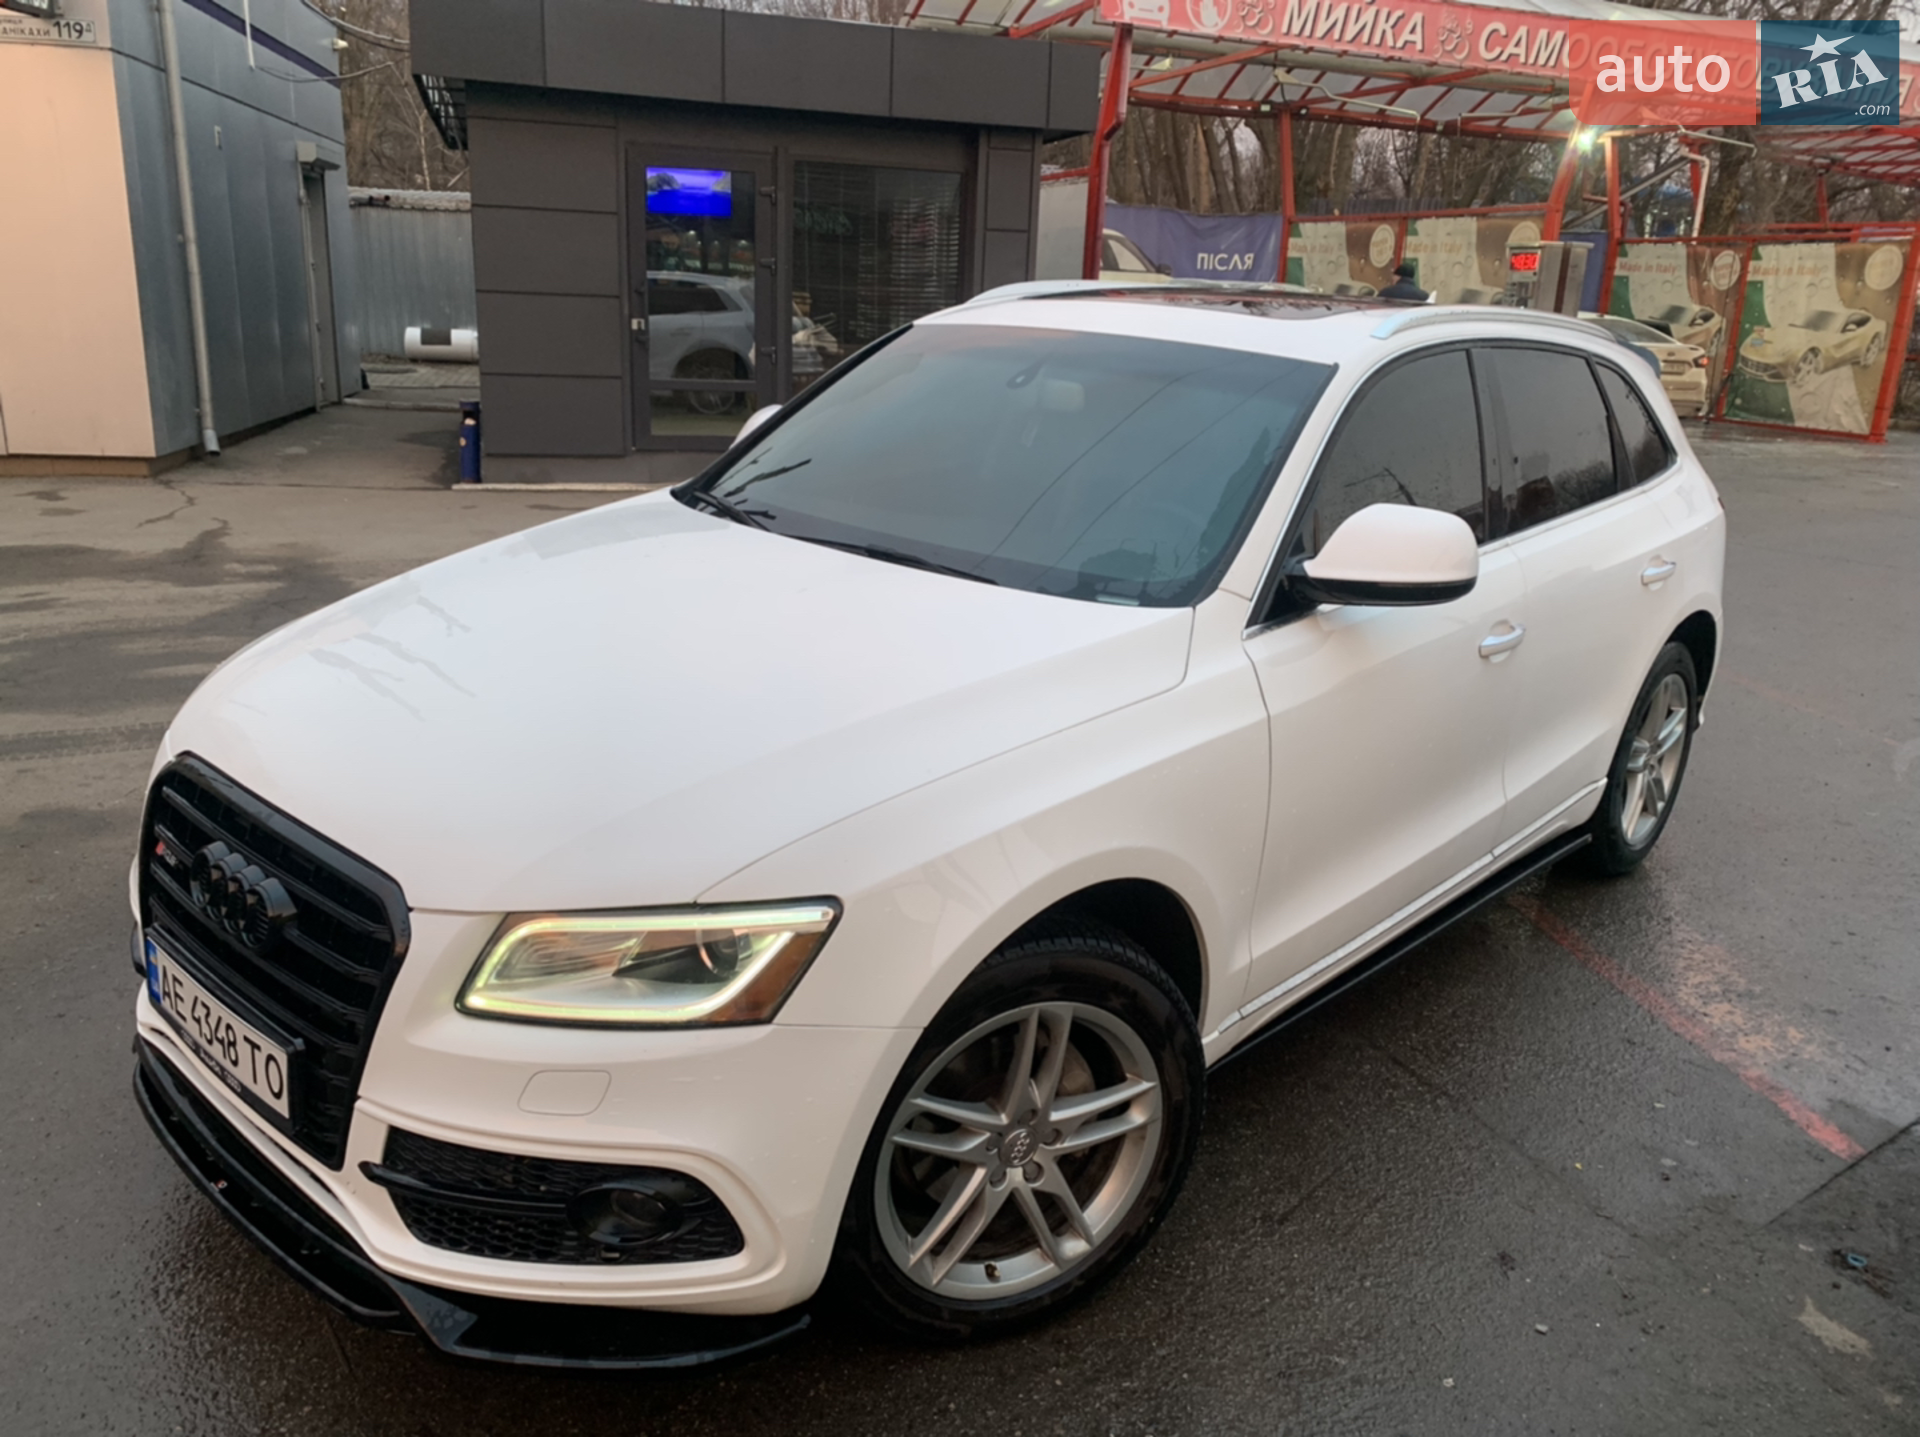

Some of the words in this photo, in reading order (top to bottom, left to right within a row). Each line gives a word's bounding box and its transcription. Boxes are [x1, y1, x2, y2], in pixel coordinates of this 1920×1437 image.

[1280, 0, 1425, 51] МИЙКА
[1196, 252, 1255, 271] ПІСЛЯ
[1619, 261, 1642, 273] Made
[1644, 261, 1653, 273] in
[1655, 262, 1677, 276] Italy
[1752, 264, 1779, 276] Made
[1783, 264, 1793, 276] in
[1796, 265, 1822, 278] Italy
[191, 995, 239, 1068] 4348
